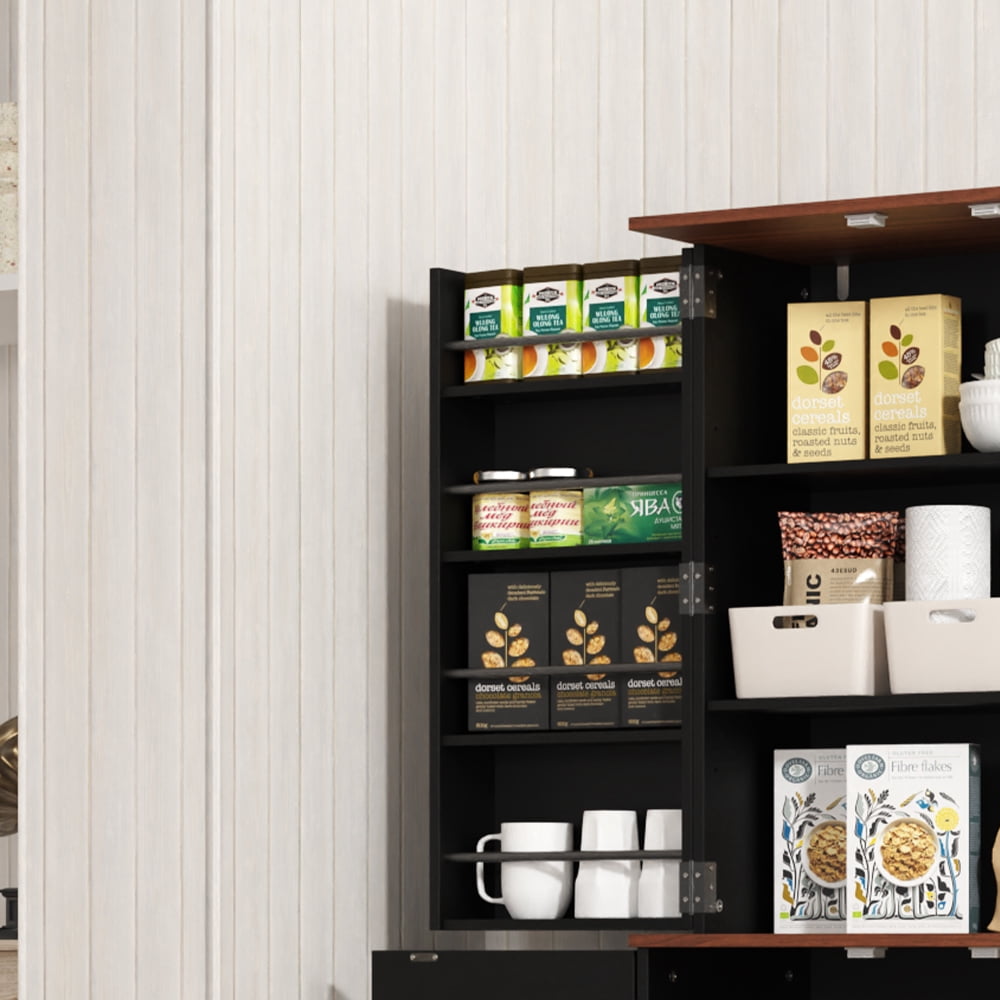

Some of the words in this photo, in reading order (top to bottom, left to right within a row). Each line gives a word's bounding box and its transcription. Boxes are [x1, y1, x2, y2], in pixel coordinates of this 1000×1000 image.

[792, 396, 844, 410] dorset
[874, 391, 921, 406] dorset
[792, 410, 851, 425] cereals
[874, 406, 928, 421] cereals
[792, 426, 827, 436] classic
[829, 426, 861, 437] fruits,
[874, 422, 906, 432] classic
[908, 421, 937, 432] fruits,
[792, 437, 831, 447] roasted
[834, 437, 857, 446] nuts
[874, 432, 910, 443] roasted
[912, 431, 934, 441] nuts
[792, 449, 802, 457] &
[803, 448, 832, 457] seeds
[874, 445, 883, 454] &
[884, 444, 911, 454] seeds
[630, 498, 671, 517] ЯВА
[475, 682, 506, 692] dorset
[506, 682, 541, 692] cereals
[556, 680, 585, 690] dorset
[585, 680, 616, 690] cereals
[628, 678, 656, 688] dorset
[656, 677, 682, 687] cereal
[818, 764, 844, 777] Fibre
[891, 760, 919, 773] Fibre
[921, 760, 953, 772] flakes
